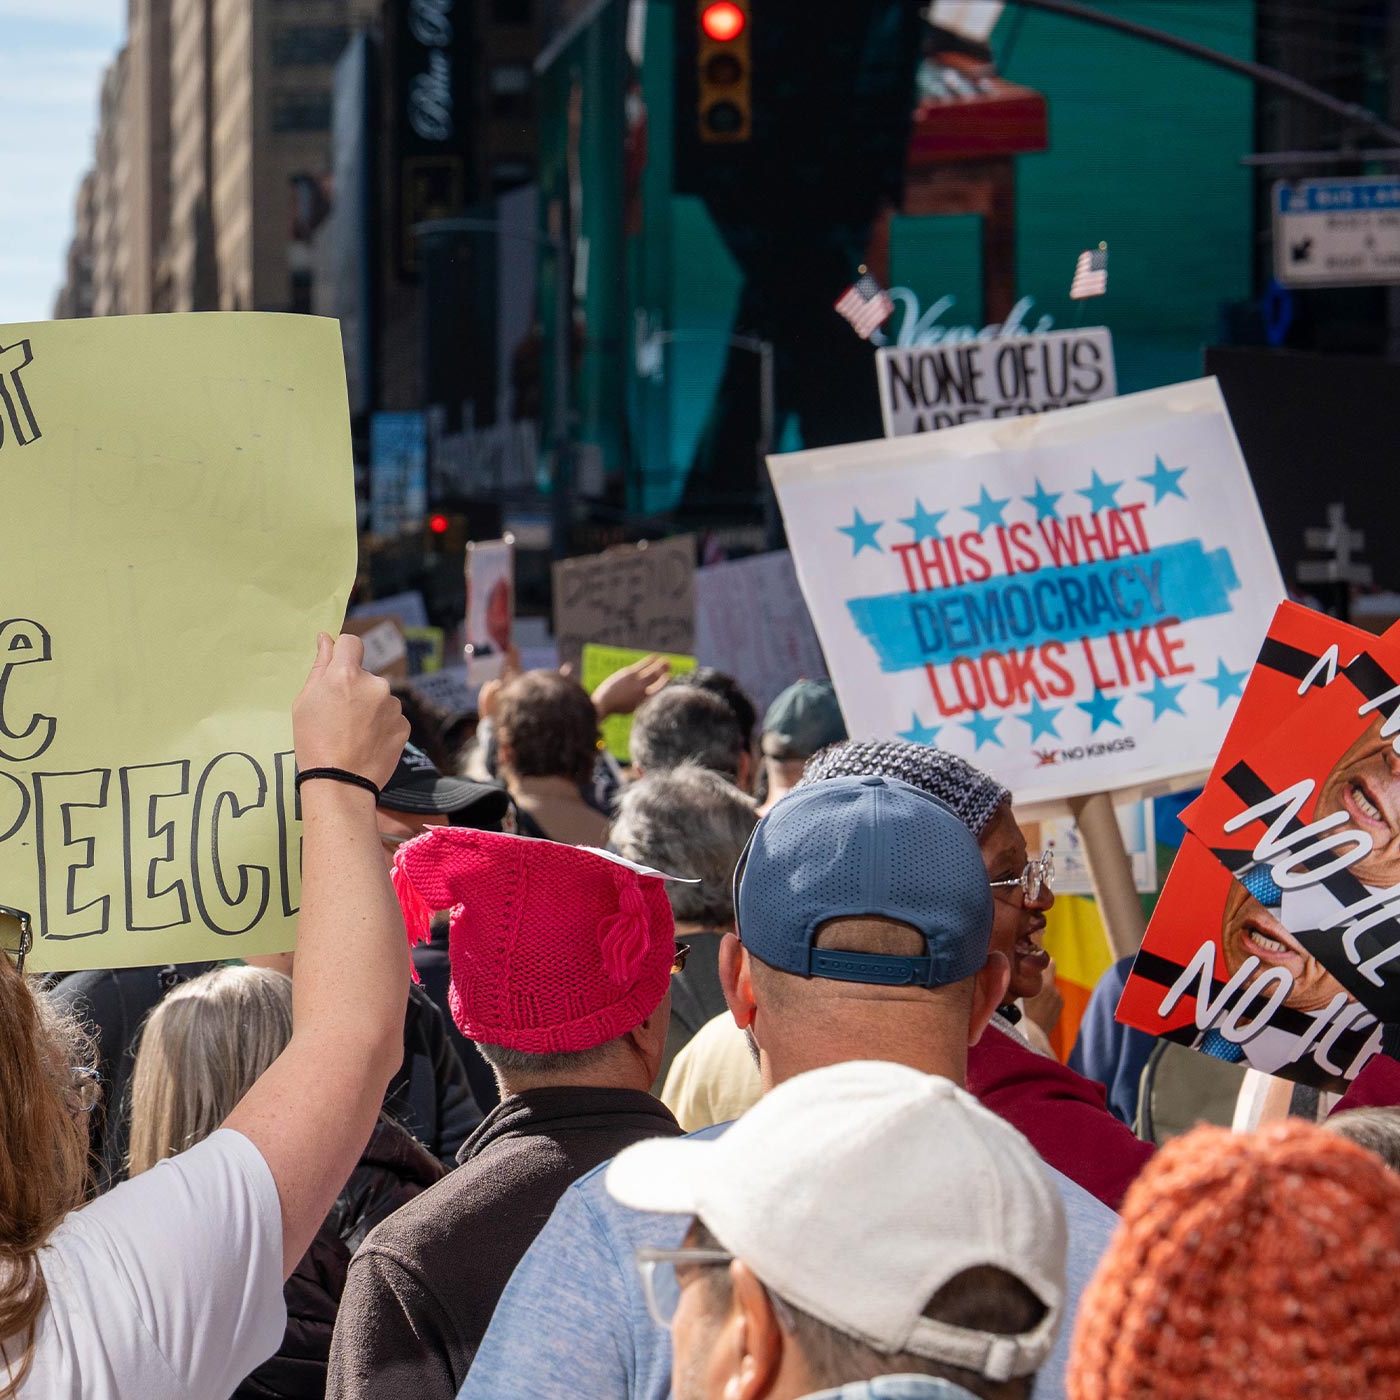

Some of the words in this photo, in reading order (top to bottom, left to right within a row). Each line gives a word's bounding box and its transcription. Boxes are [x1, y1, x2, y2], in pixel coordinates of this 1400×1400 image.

[887, 346, 985, 411] NONE
[997, 341, 1037, 402] OF
[1043, 337, 1103, 399] US
[891, 530, 992, 594] THIS
[995, 520, 1041, 576] IS
[1038, 503, 1151, 570] WHAT
[908, 558, 1166, 656] DEMOCRACY
[925, 639, 1076, 718] LOOKS
[1080, 615, 1196, 691] LIKE
[1061, 746, 1085, 765] NO
[1086, 735, 1137, 759] KINGS
[1222, 777, 1374, 890] NO
[1156, 938, 1295, 1044] NO
